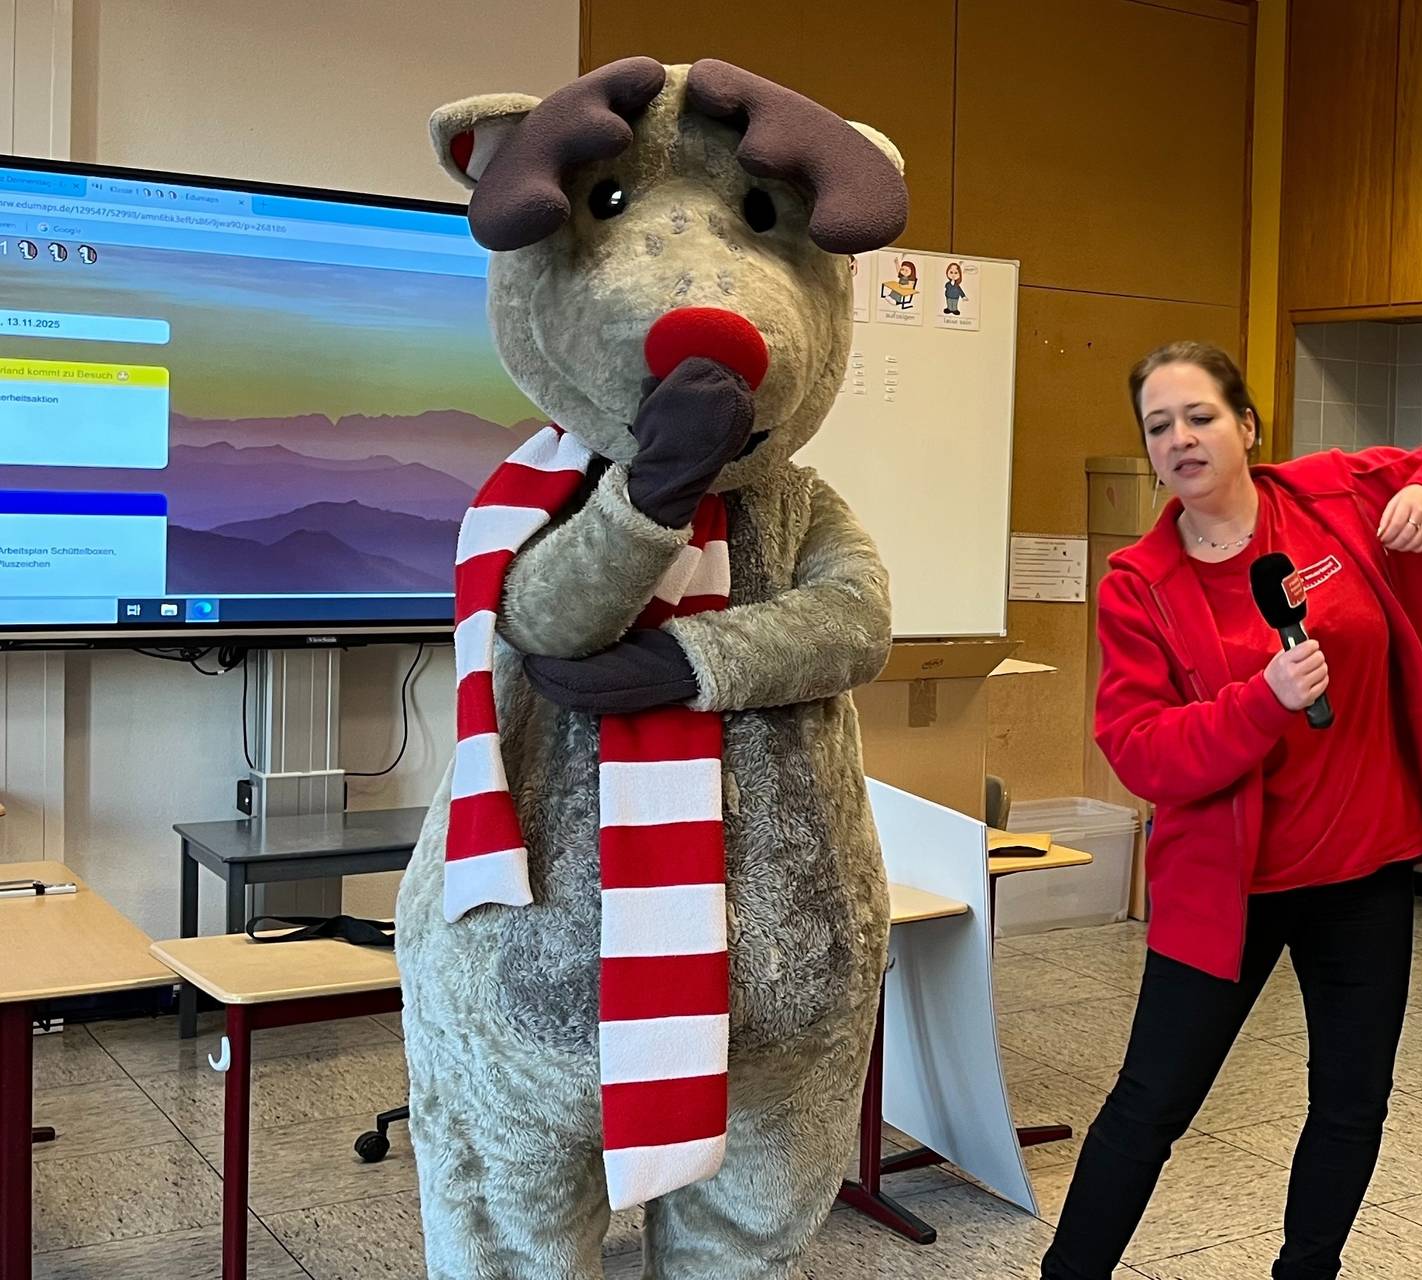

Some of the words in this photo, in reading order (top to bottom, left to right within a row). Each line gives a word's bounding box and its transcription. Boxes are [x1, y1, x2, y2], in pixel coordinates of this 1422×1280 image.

[8, 317, 60, 329] 13.11.2025
[27, 368, 60, 376] kommt
[78, 370, 113, 380] Besuch
